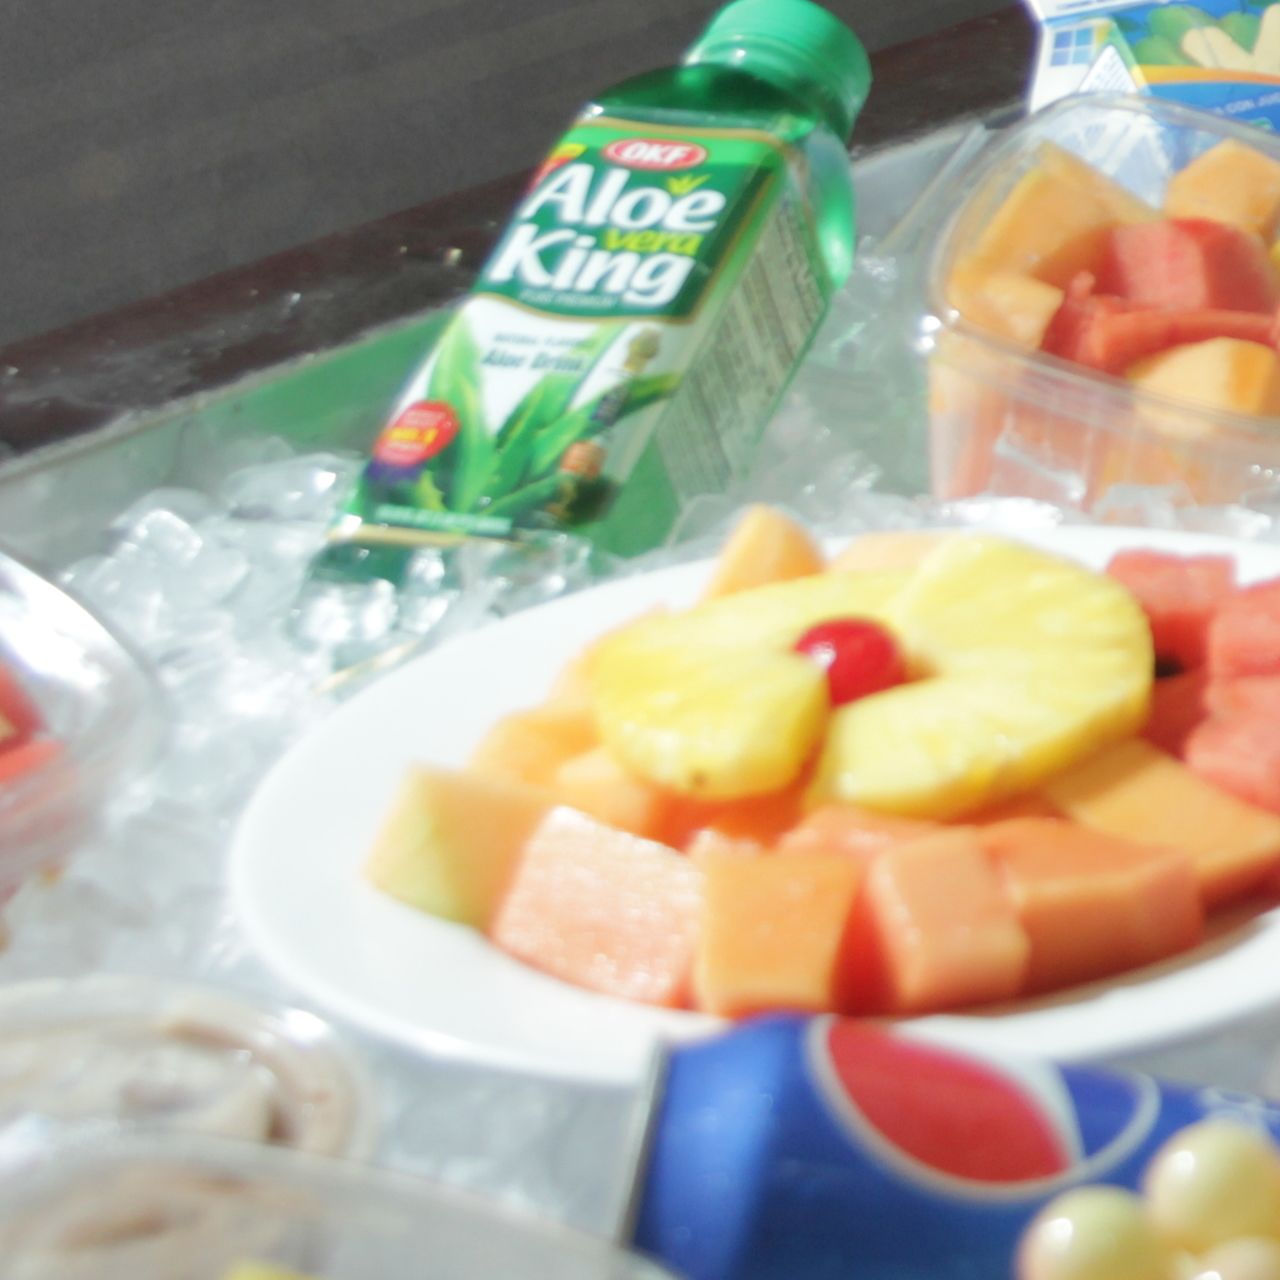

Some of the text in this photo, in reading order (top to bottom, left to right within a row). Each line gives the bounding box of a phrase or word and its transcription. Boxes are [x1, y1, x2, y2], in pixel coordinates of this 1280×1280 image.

[620, 140, 693, 166] OKF
[519, 162, 727, 233] Aloe
[488, 222, 696, 307] King
[605, 228, 704, 256] vera
